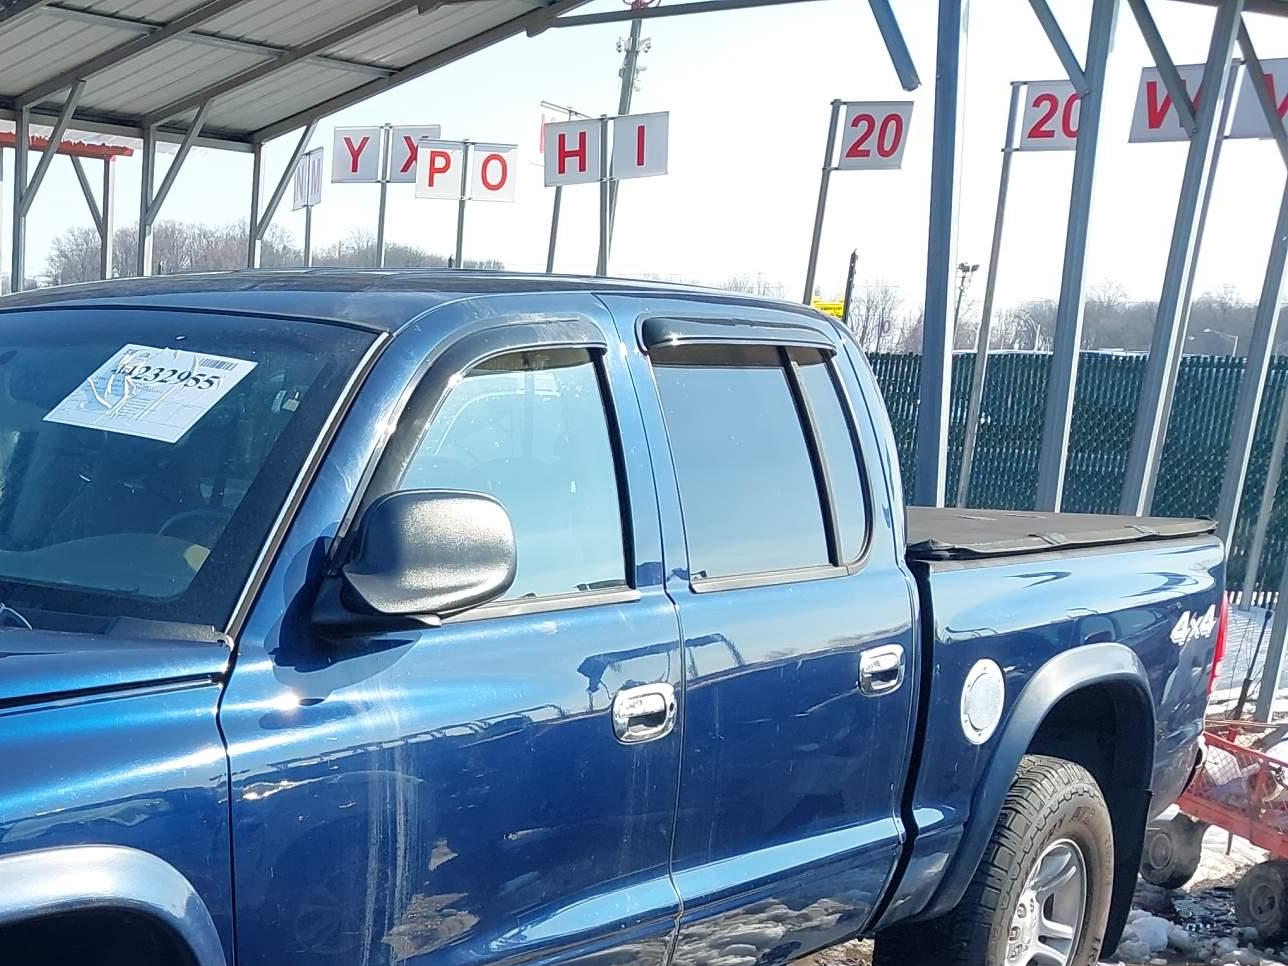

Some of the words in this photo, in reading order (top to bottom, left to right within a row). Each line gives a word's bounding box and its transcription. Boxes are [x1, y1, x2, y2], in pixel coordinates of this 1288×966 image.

[343, 136, 371, 173] Y
[557, 131, 587, 174] H
[636, 125, 646, 167] I
[845, 112, 904, 158] 20
[427, 150, 452, 187] P
[480, 153, 509, 191] O
